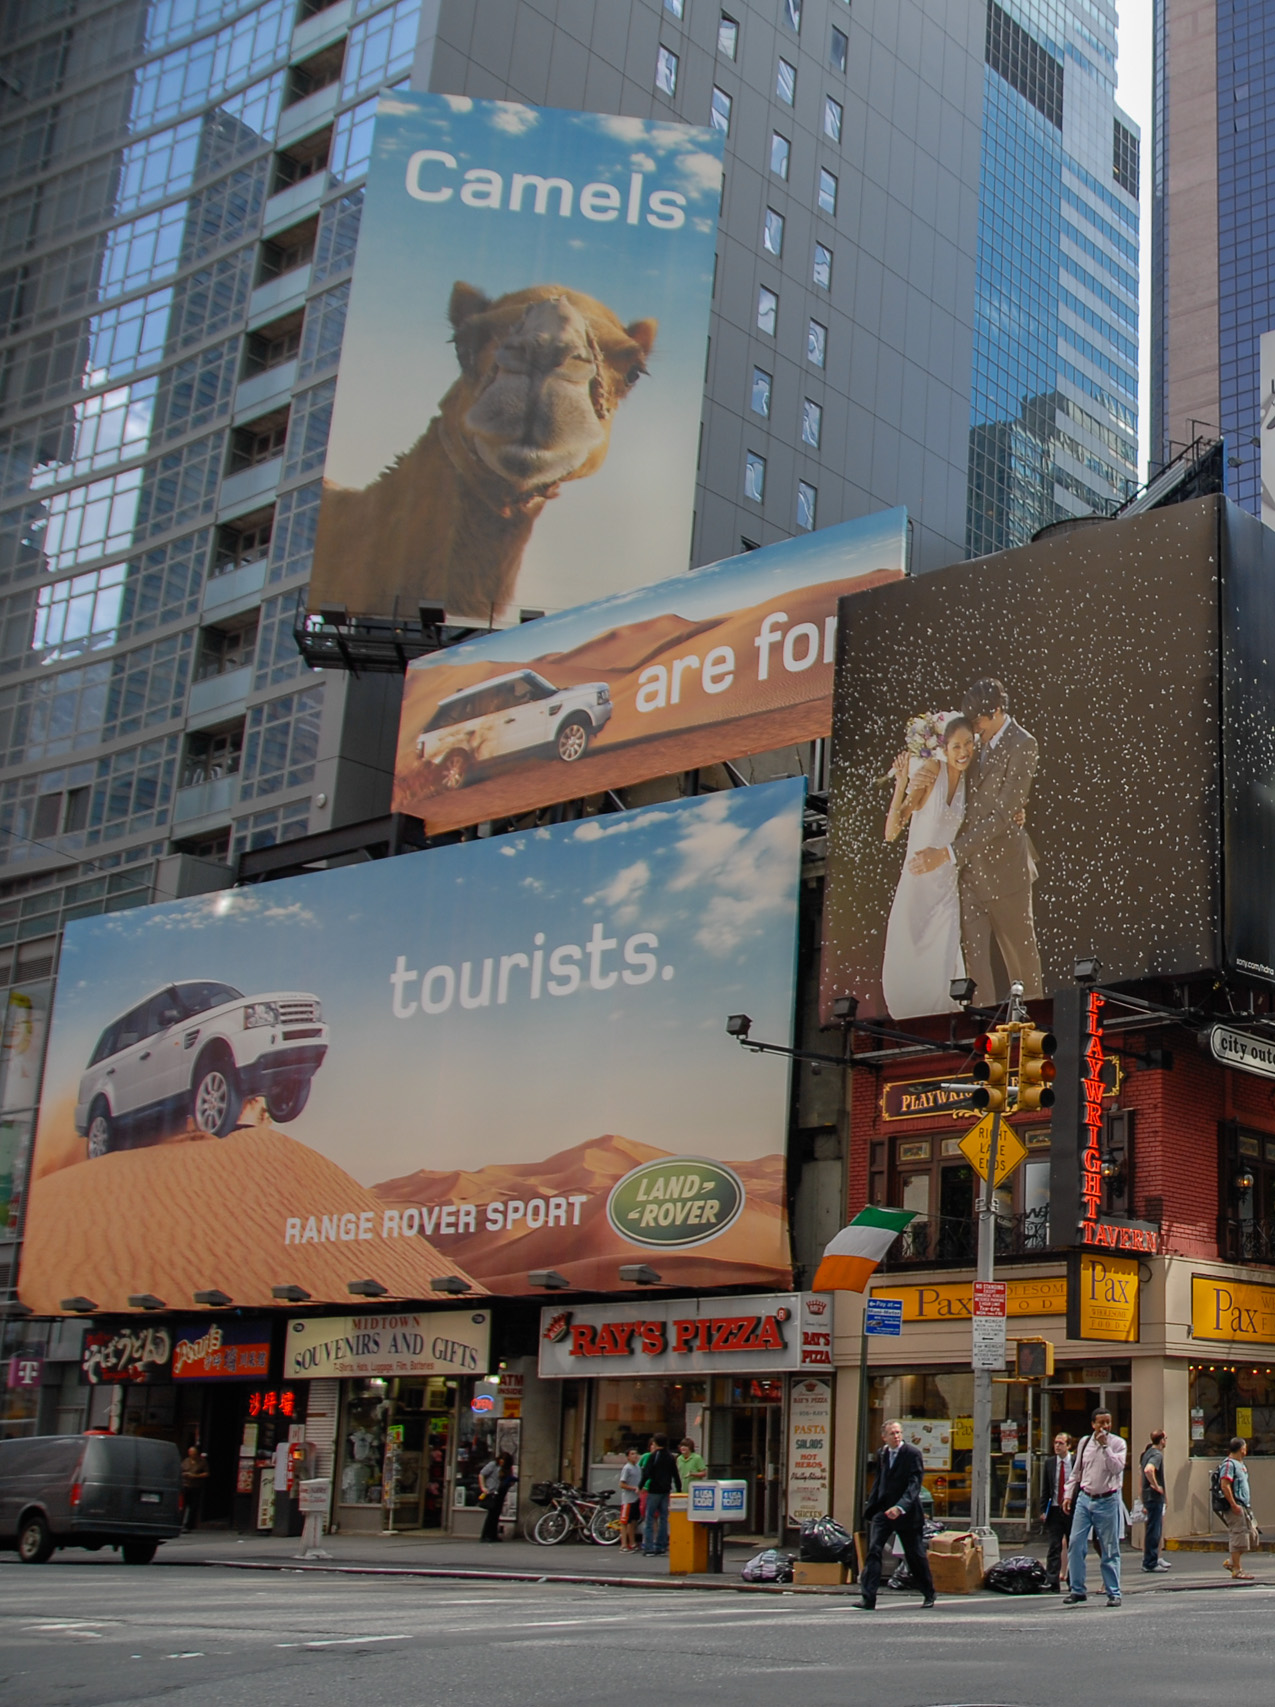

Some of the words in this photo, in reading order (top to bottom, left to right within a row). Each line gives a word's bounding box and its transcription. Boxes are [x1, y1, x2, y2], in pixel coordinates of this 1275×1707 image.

[405, 149, 687, 231] Camels
[636, 644, 736, 713] are
[390, 923, 675, 1019] tourists.
[1221, 1035, 1248, 1060] city
[1081, 991, 1105, 1219] PLAYWRIGHT
[980, 1142, 1005, 1156] LAE
[637, 1173, 702, 1199] LAND
[284, 1213, 374, 1245] RANGE
[383, 1204, 478, 1239] ROVER
[486, 1195, 588, 1232] SPORT
[641, 1200, 721, 1228] ROVER
[1080, 1219, 1159, 1253] TAVERN
[1089, 1259, 1130, 1304] Pax
[915, 1288, 973, 1317] Pax
[1089, 1308, 1127, 1319] WHOLESOME
[1213, 1287, 1258, 1334] Pax
[352, 1315, 421, 1331] MIDTOWN
[569, 1320, 667, 1356] RAY'S
[672, 1315, 784, 1353] PIZZA
[1091, 1320, 1128, 1330] FOODS
[802, 1331, 831, 1346] RAY'S
[294, 1332, 380, 1375] SOUVENIRS
[388, 1332, 424, 1356] AND
[432, 1336, 478, 1371] GIFTS
[801, 1349, 832, 1364] PIZZA
[18, 1361, 39, 1384] T
[501, 1373, 524, 1386] ATM
[794, 1424, 827, 1436] PASTA
[1236, 1411, 1251, 1426] Pax
[795, 1438, 824, 1450] SALADS
[795, 1461, 823, 1469] HEROS
[801, 1453, 818, 1461] HOT
